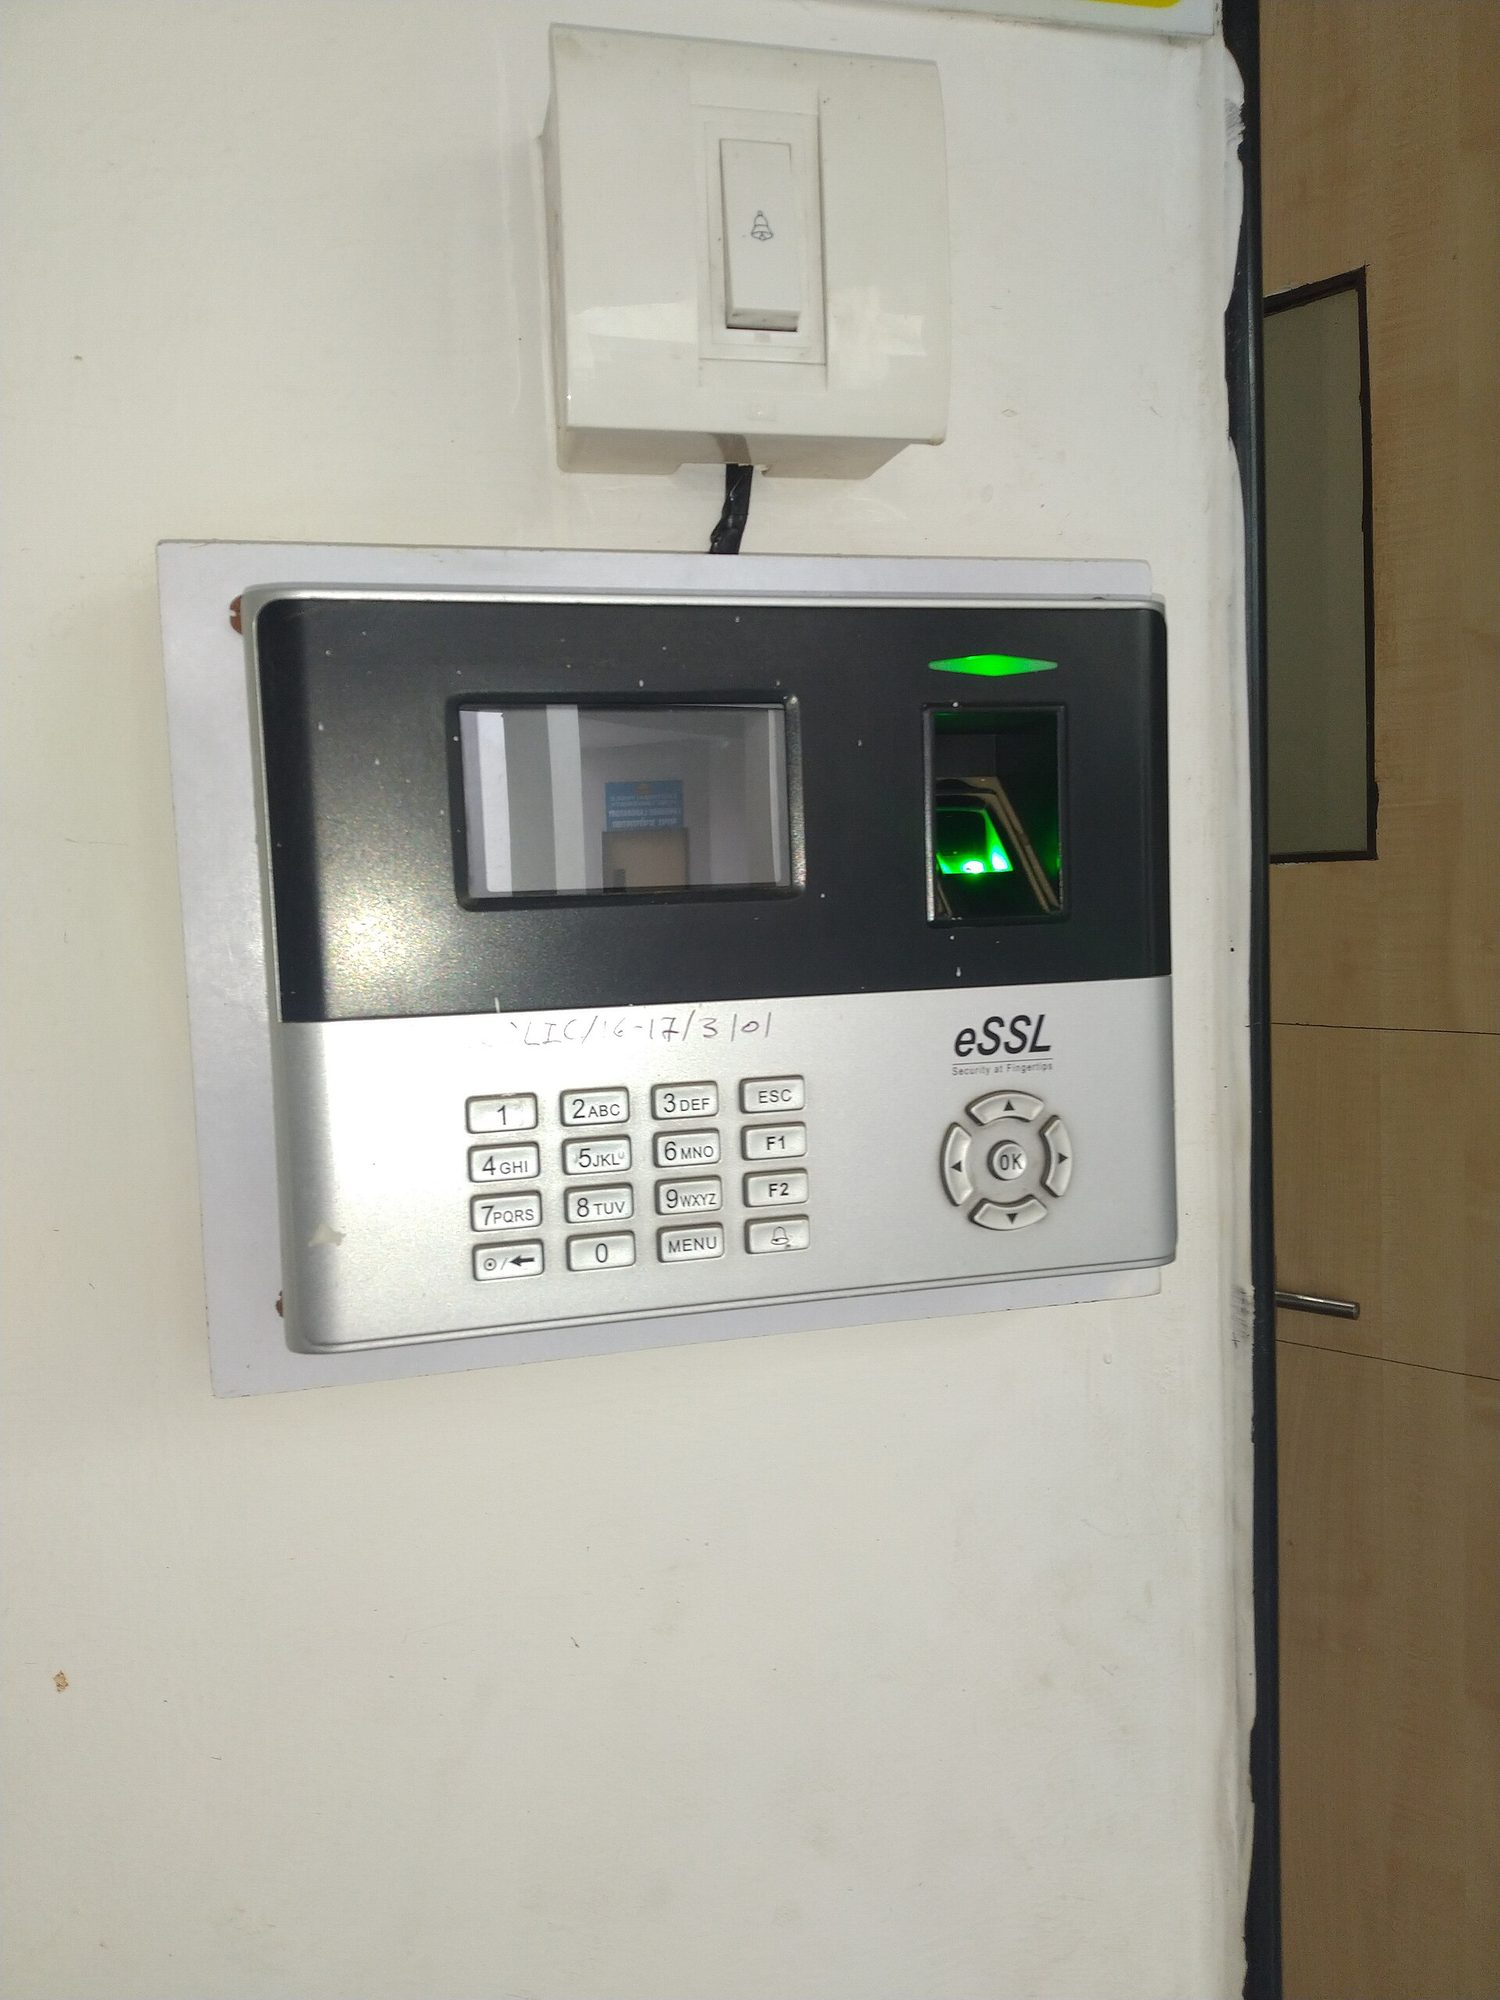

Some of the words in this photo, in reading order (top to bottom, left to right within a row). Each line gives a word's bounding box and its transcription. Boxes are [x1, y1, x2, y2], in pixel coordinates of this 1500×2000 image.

[954, 1014, 1052, 1057] eSSL
[952, 1066, 990, 1076] Security
[994, 1065, 1004, 1074] at
[1006, 1062, 1053, 1074] Fingertips
[758, 1088, 793, 1104] ESC
[497, 1105, 507, 1125] 1
[766, 1135, 786, 1150] F1
[1000, 1153, 1023, 1171] OK
[768, 1182, 789, 1197] F2
[595, 1243, 608, 1263] 0
[668, 1236, 717, 1254] MENU
